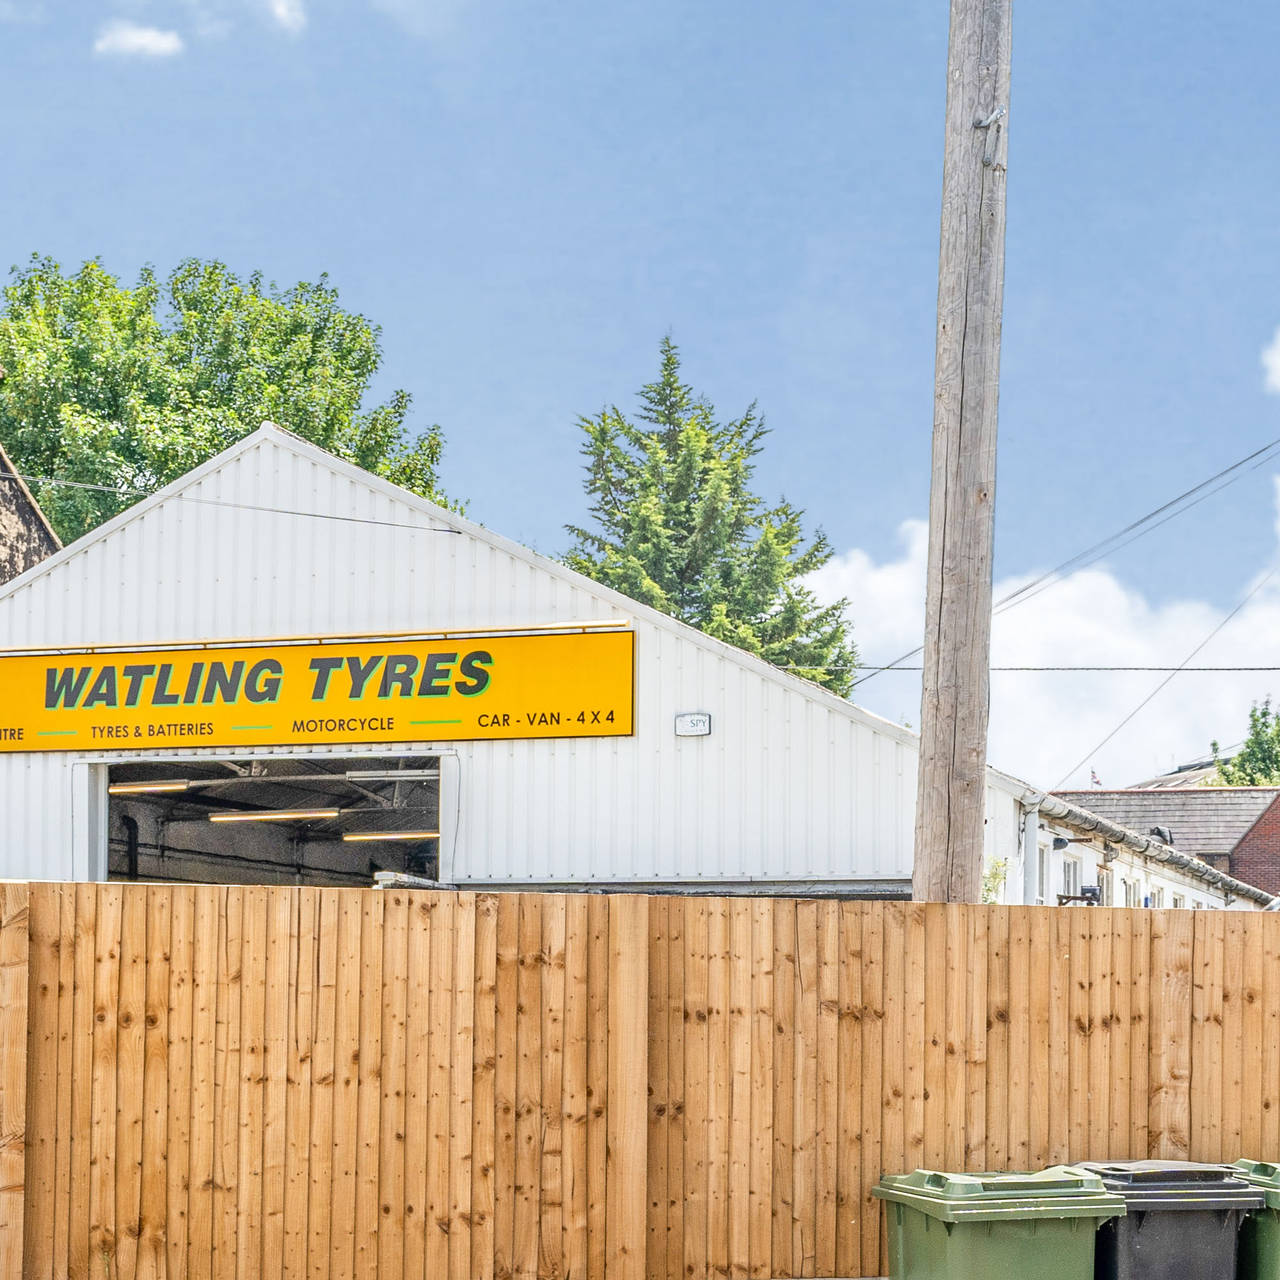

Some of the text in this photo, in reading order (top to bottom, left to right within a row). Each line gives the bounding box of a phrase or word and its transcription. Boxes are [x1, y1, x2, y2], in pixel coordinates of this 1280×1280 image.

[45, 651, 494, 709] WATLING TYRES
[292, 717, 394, 733] MOTORCYCLE
[477, 713, 510, 728] CAR
[526, 712, 561, 726] VAN
[576, 711, 586, 724] 4
[590, 710, 601, 724] X
[605, 710, 615, 724] 4
[91, 722, 214, 738] TYRES & BATTERIES
